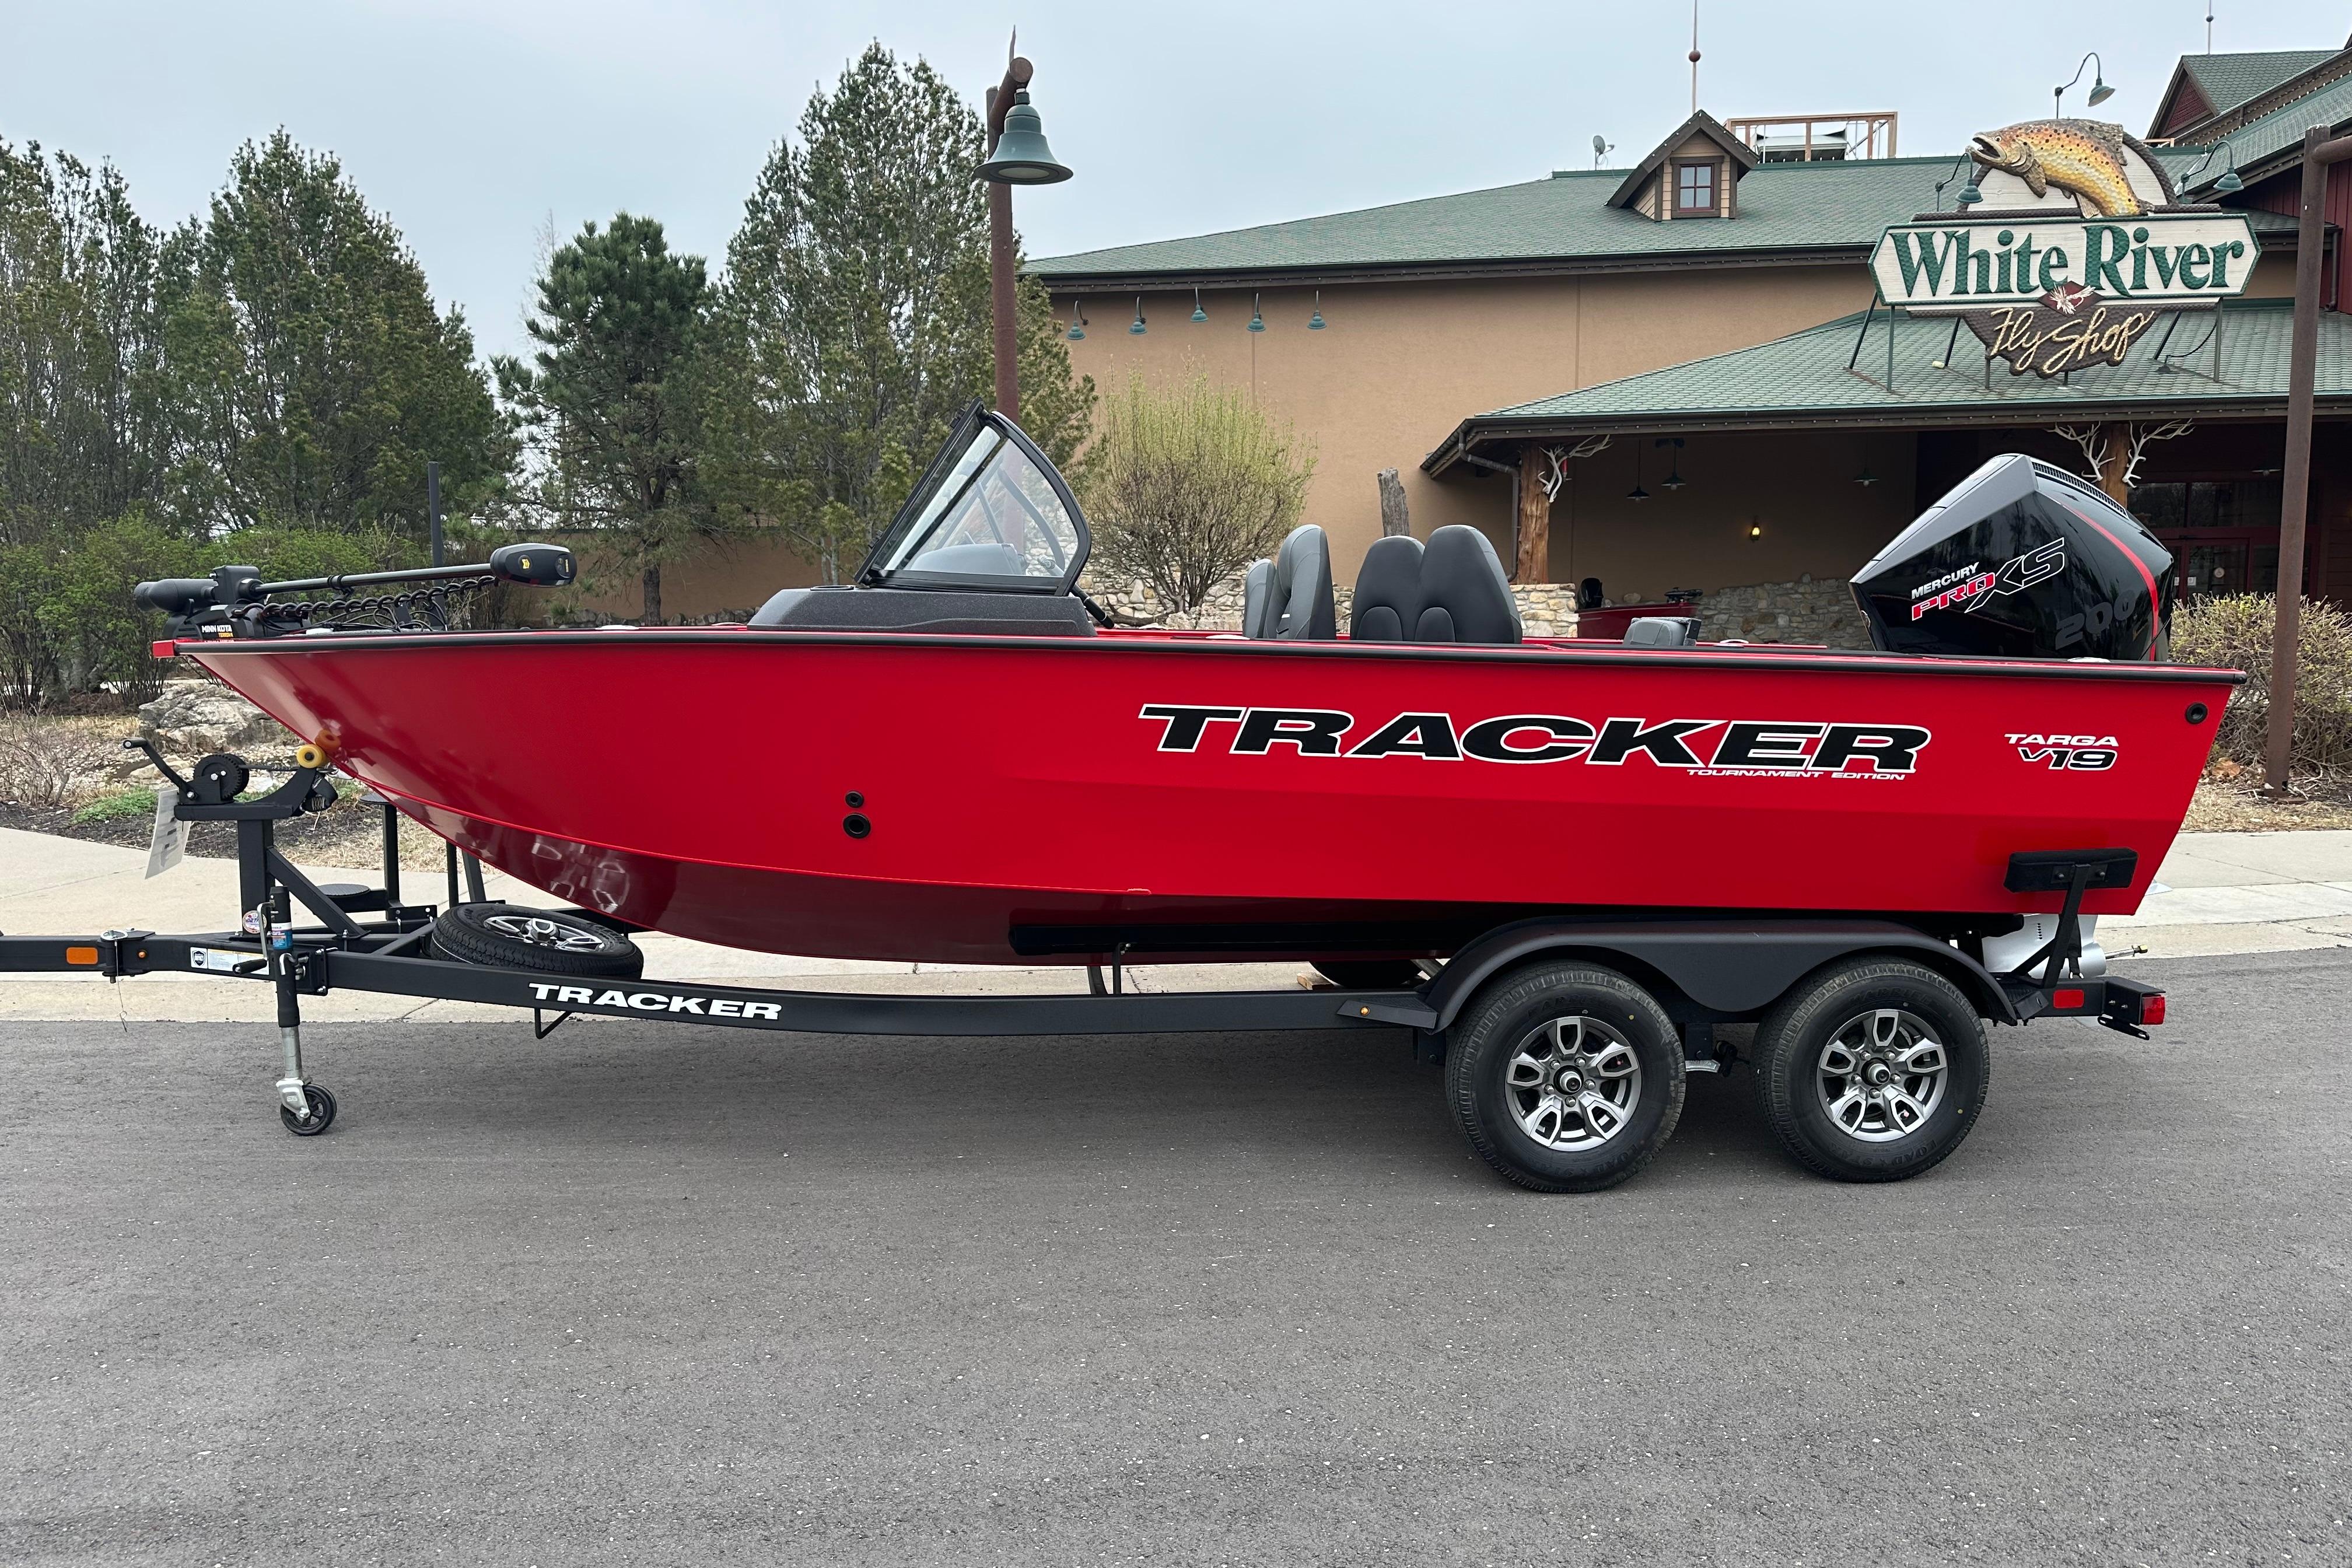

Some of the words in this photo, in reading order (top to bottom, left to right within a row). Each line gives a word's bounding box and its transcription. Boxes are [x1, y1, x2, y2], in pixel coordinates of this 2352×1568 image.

[1888, 229, 2068, 297] White
[2084, 224, 2245, 298] River
[1990, 307, 2042, 370] Fly
[2043, 307, 2155, 373] Shop
[1912, 562, 1979, 600] MERCURY
[2055, 590, 2136, 650] 200
[1138, 703, 1932, 773] TRACKER
[2004, 734, 2119, 747] TARGA
[1687, 769, 1824, 778] TOURNAMENT
[2017, 747, 2118, 771] V19
[528, 983, 782, 1020] TRACKER
